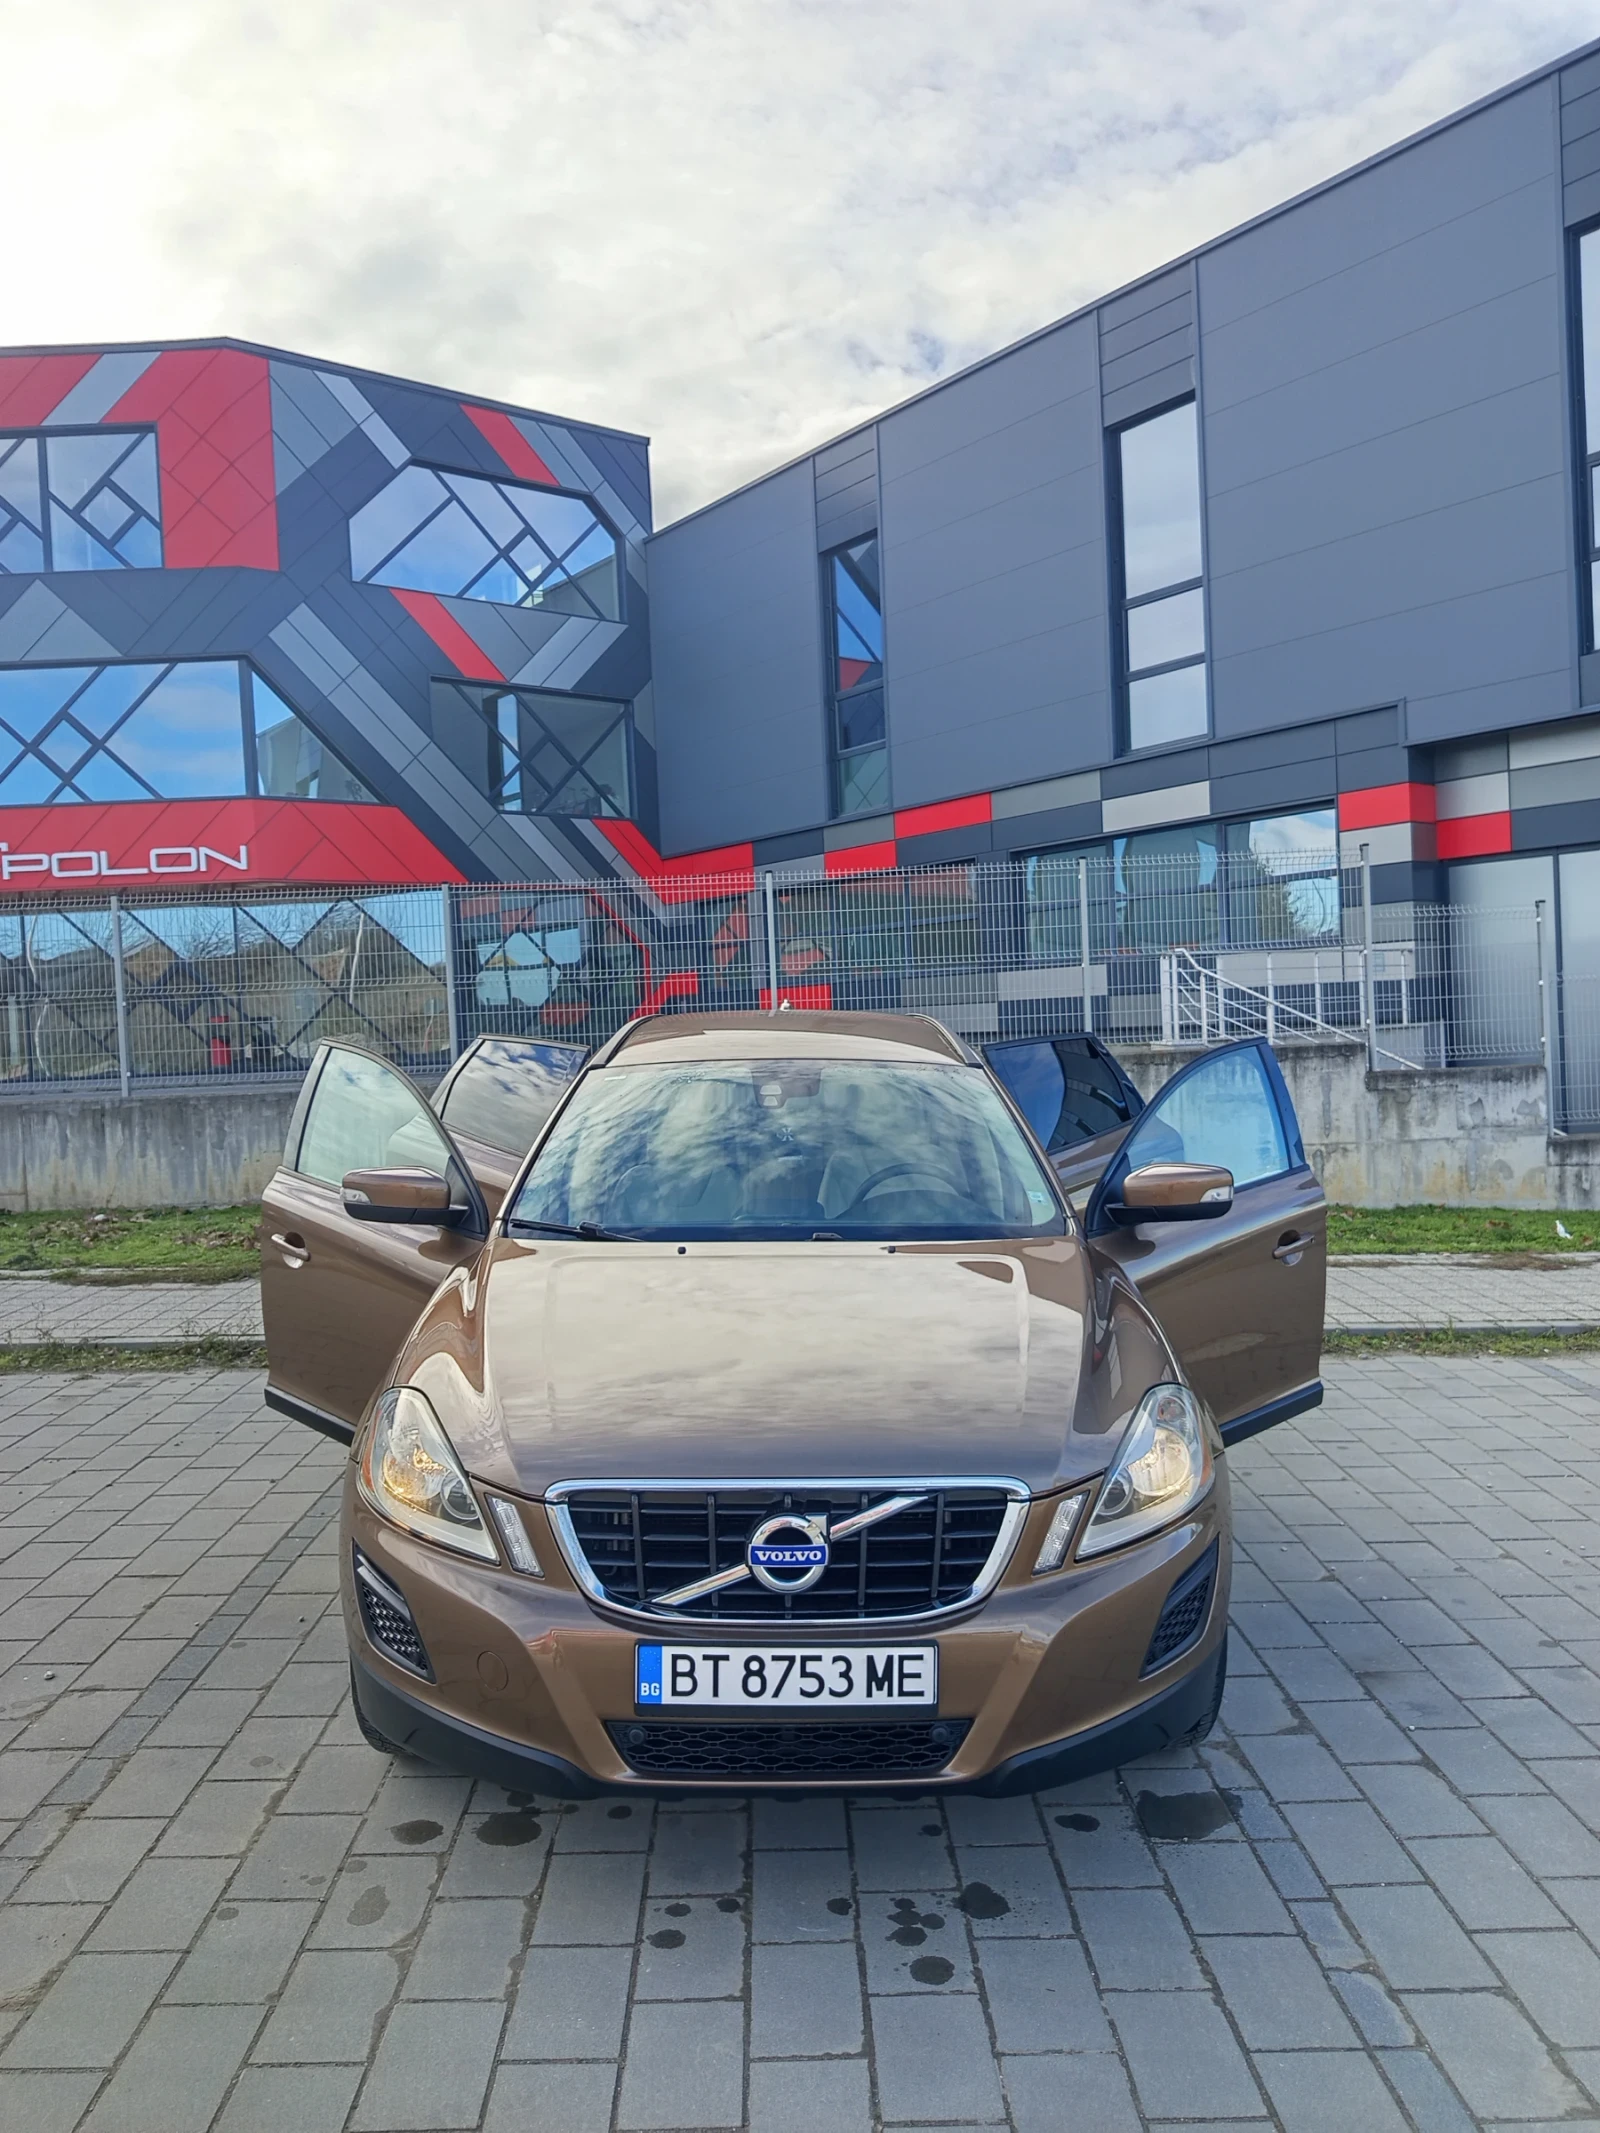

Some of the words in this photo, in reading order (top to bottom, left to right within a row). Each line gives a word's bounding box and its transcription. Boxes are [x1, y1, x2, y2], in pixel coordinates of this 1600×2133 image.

[0, 842, 248, 880] POLON
[754, 1550, 822, 1562] VOLVO
[670, 1653, 730, 1699] BT
[741, 1654, 854, 1699] 8753
[866, 1654, 925, 1698] ME
[640, 1682, 660, 1697] BG
